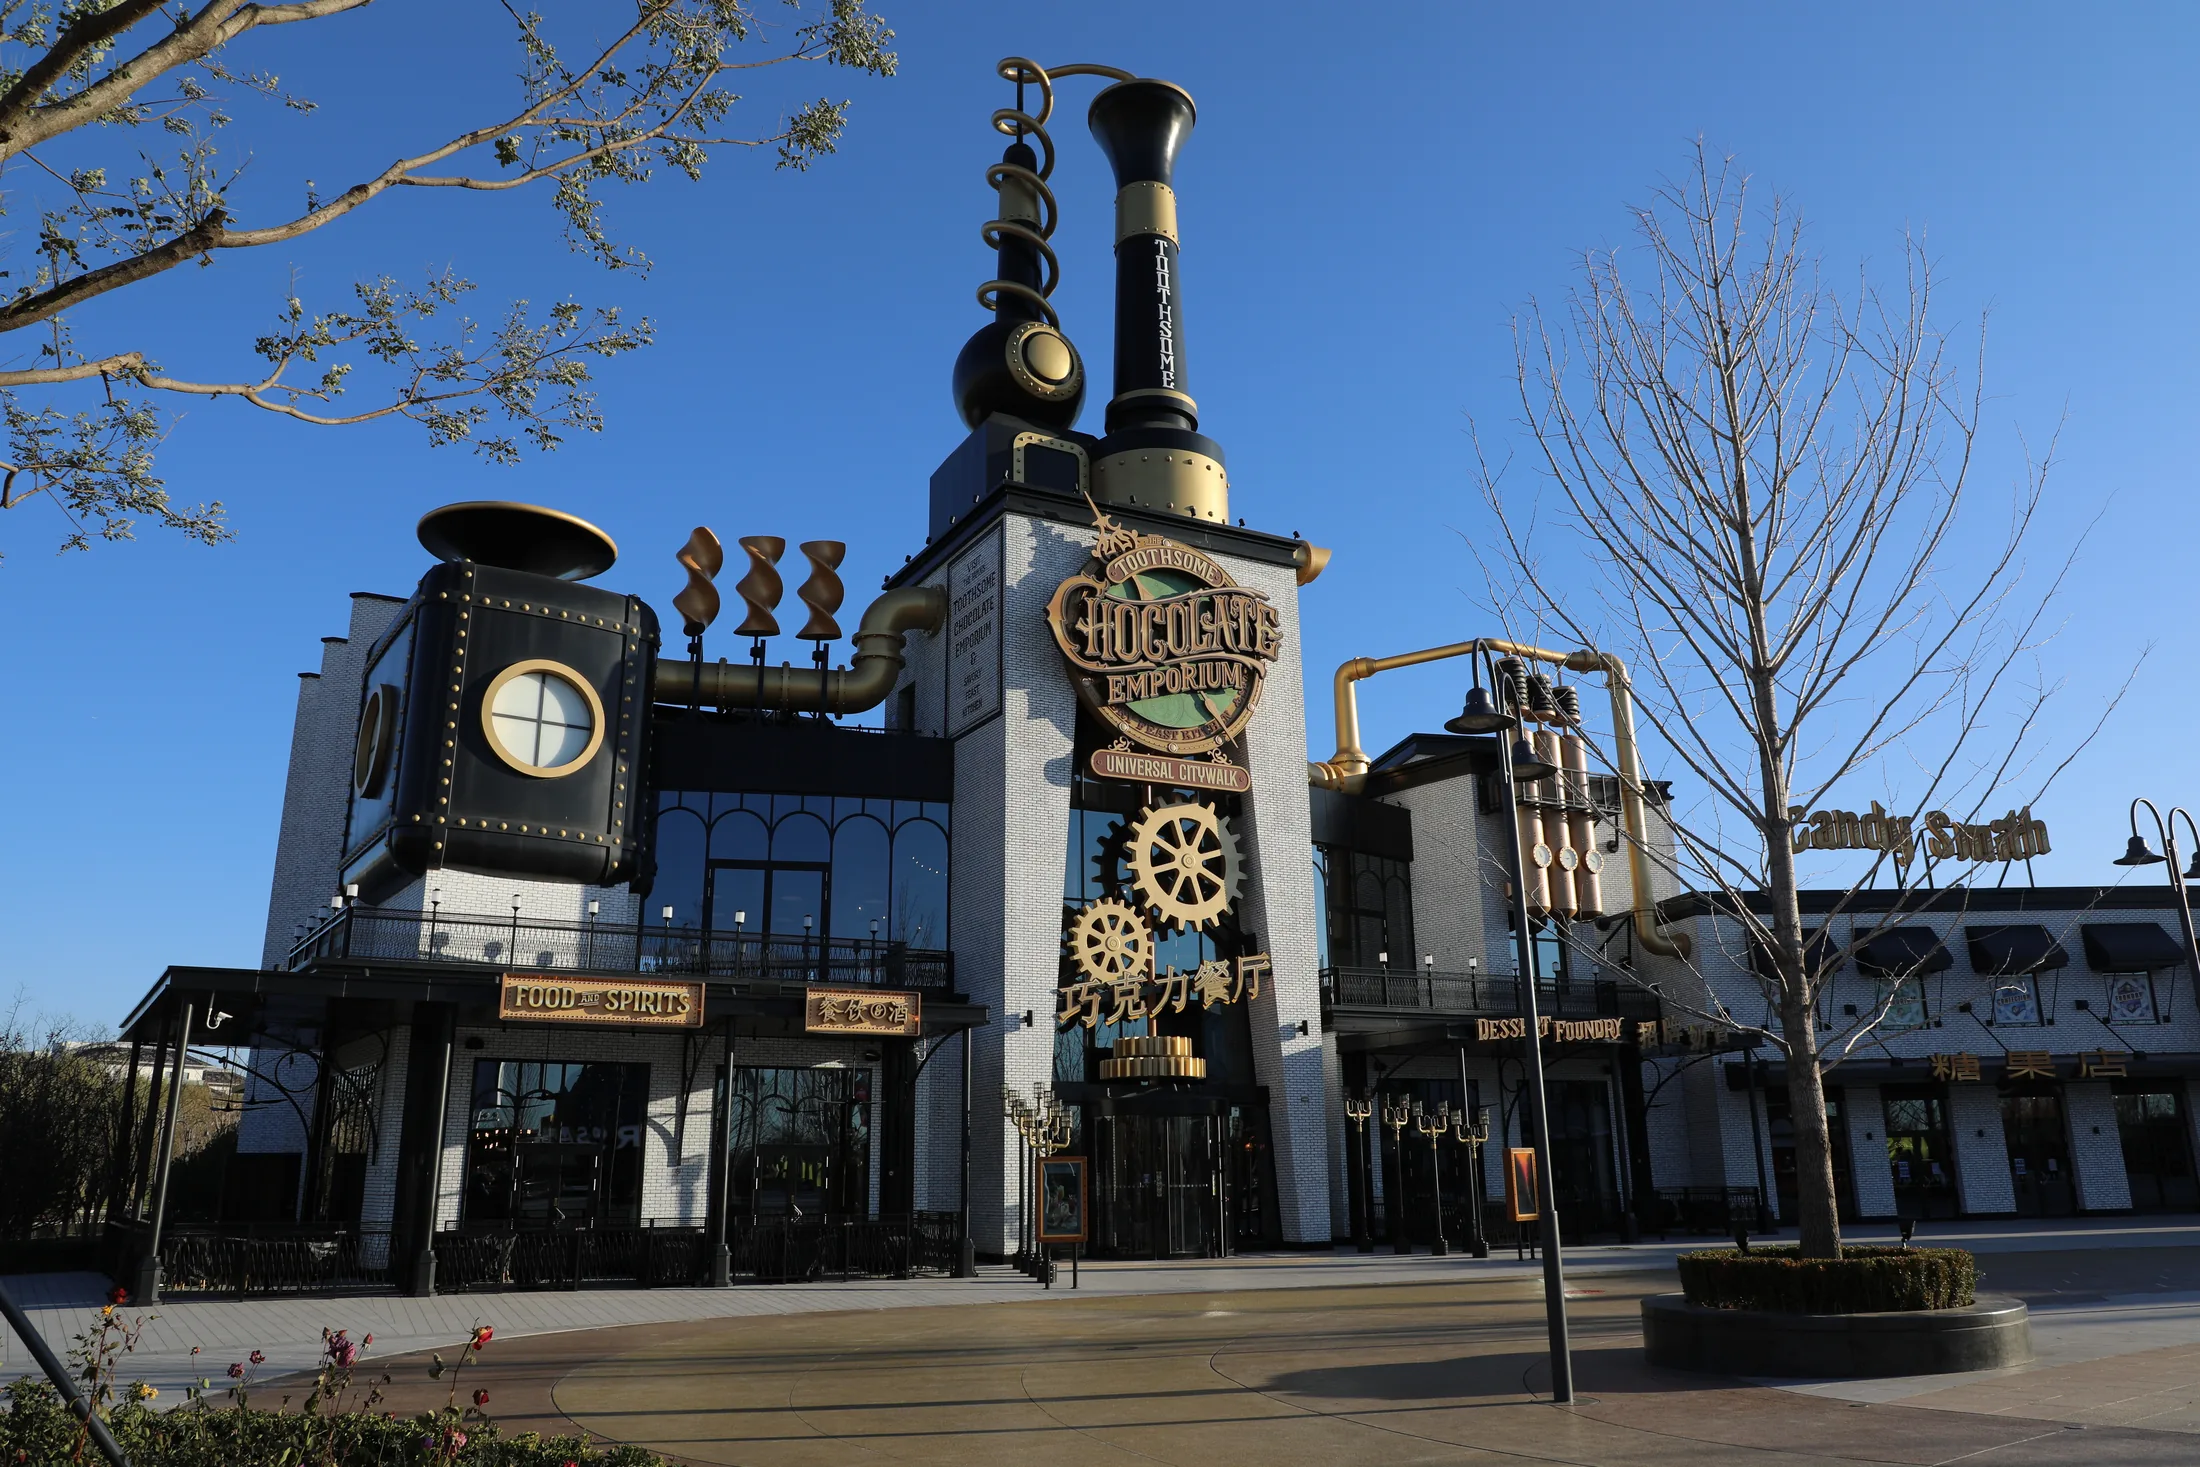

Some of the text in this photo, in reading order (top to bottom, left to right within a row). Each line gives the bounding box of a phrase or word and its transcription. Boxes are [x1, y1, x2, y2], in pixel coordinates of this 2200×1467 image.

[1154, 239, 1175, 389] TOOTHSOME
[1114, 548, 1217, 581] TOOTHSOME
[953, 571, 996, 615] TOOTHSOME
[953, 595, 995, 637] CHOCOLATE
[1043, 573, 1284, 671] CHOCOLATE
[955, 620, 992, 658] EMPORIUM
[970, 652, 977, 666] &
[965, 684, 981, 700] FEAST
[1107, 662, 1244, 704] EMPORIUM
[1135, 722, 1179, 741] FEAST
[1181, 711, 1232, 741] KITCHN
[1106, 754, 1239, 787] UNIVERSAL CITYWALK
[515, 985, 691, 1015] FOOD AND SPIRITS
[1058, 951, 1271, 1028] 巧克力餐厅
[1552, 1017, 1625, 1043] FOUNDRY
[1929, 1048, 2128, 1081] 糖果店
